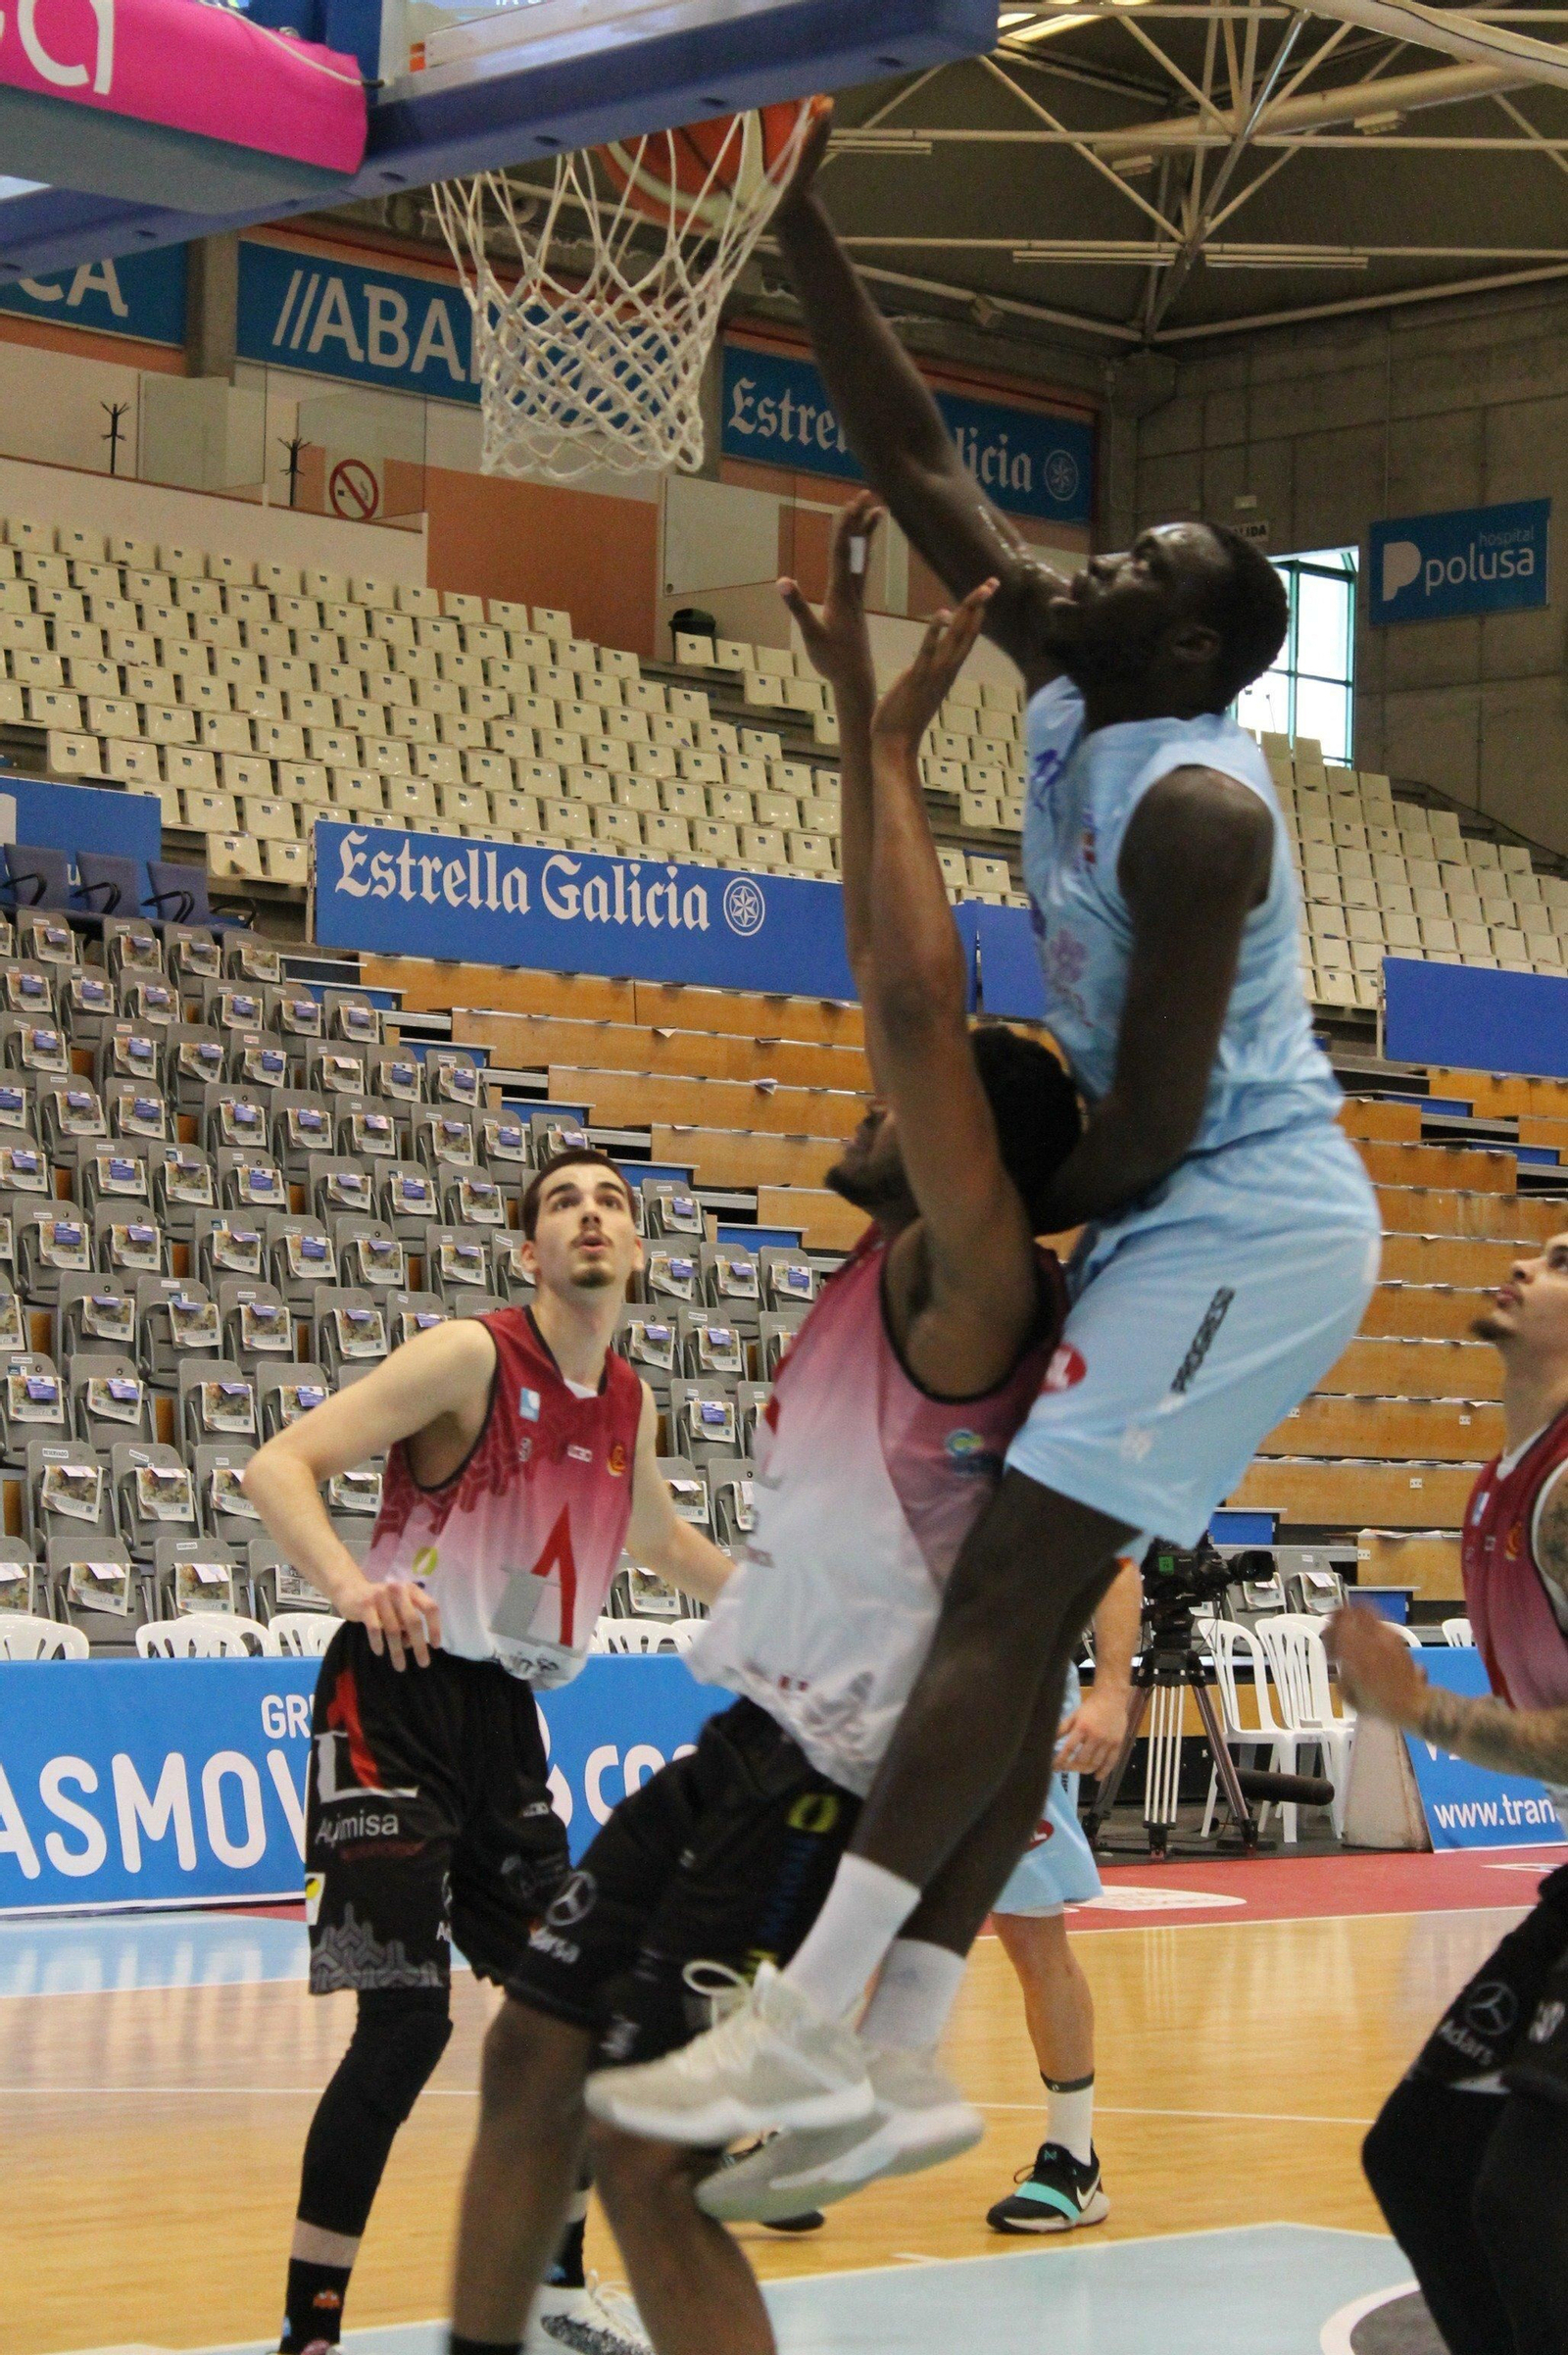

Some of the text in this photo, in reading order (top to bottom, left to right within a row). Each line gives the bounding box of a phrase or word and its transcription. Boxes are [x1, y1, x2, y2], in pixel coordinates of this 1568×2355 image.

[955, 426, 1033, 492] licia
[1478, 524, 1535, 548] hospital
[1426, 543, 1534, 596] polusa
[335, 829, 710, 932] Estrella Galicia
[262, 1694, 314, 1739] GR
[1434, 1793, 1561, 1829] www.tran
